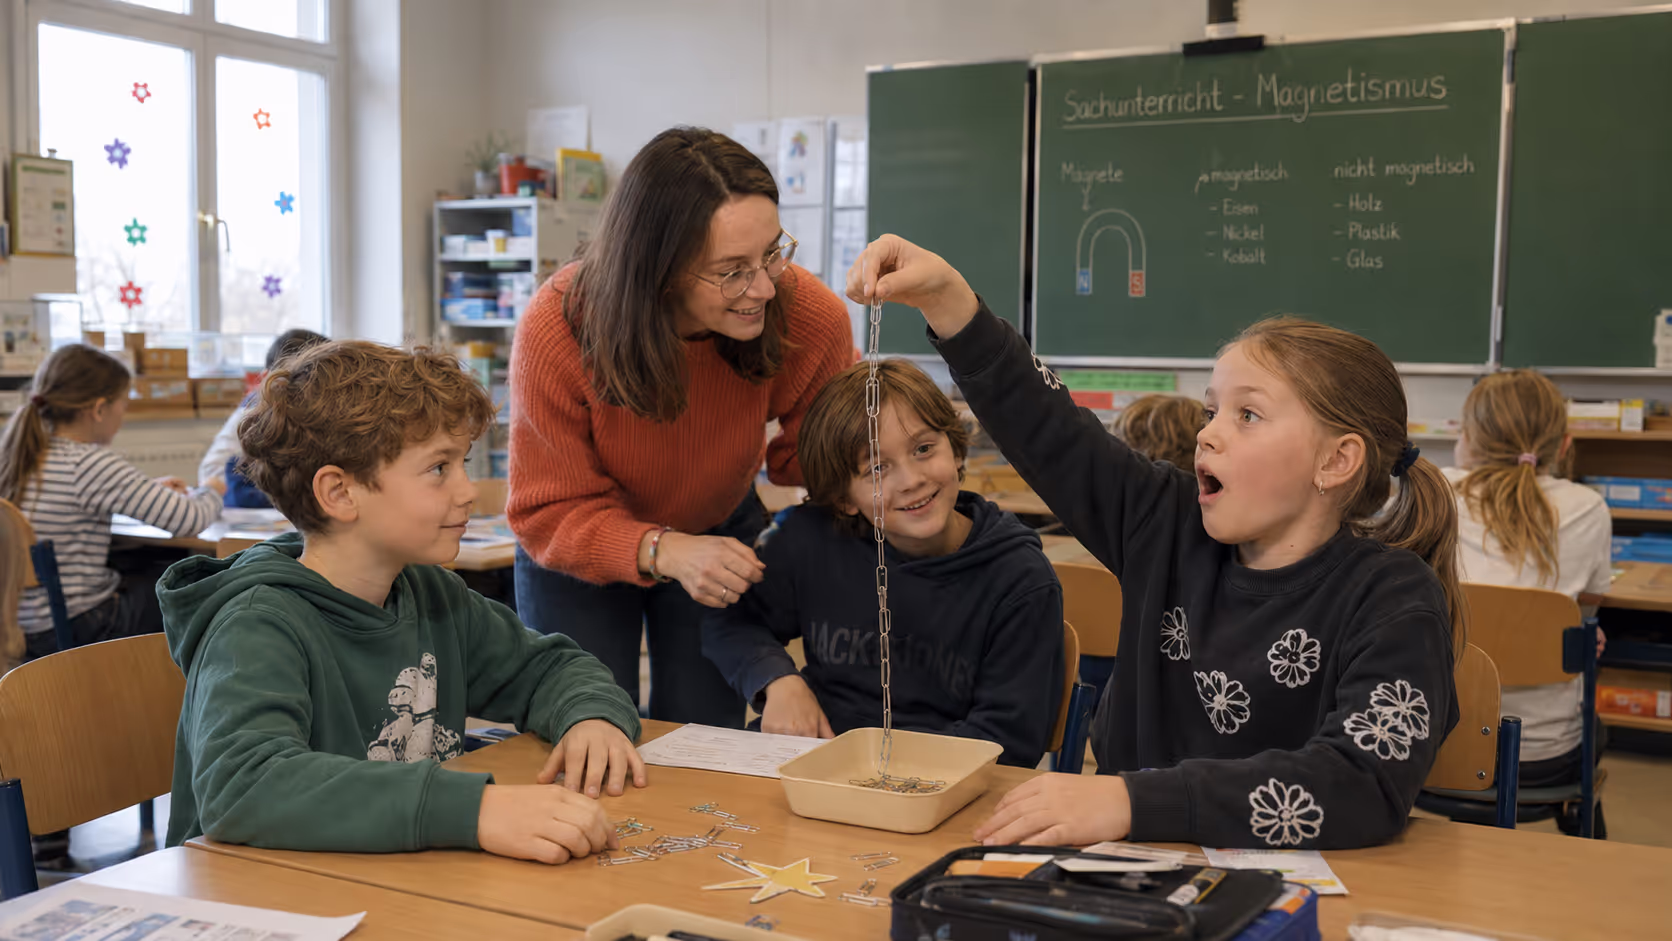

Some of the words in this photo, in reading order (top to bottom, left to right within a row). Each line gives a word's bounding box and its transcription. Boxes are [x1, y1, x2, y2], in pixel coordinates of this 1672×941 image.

[1064, 78, 1224, 121] Sachunterricht
[1257, 67, 1448, 123] Magnetismus
[1061, 161, 1125, 194] Magnete
[1210, 160, 1289, 191] magnetisch
[1333, 156, 1376, 178] nicht
[1384, 153, 1475, 186] magnetisch
[1222, 198, 1259, 216] Eisen
[1349, 193, 1383, 212] Holz
[1222, 223, 1265, 241] Nickel
[1348, 221, 1402, 240] Plastik
[1222, 247, 1266, 265] Kobalt
[1346, 249, 1384, 269] Glas
[1132, 275, 1143, 292] S
